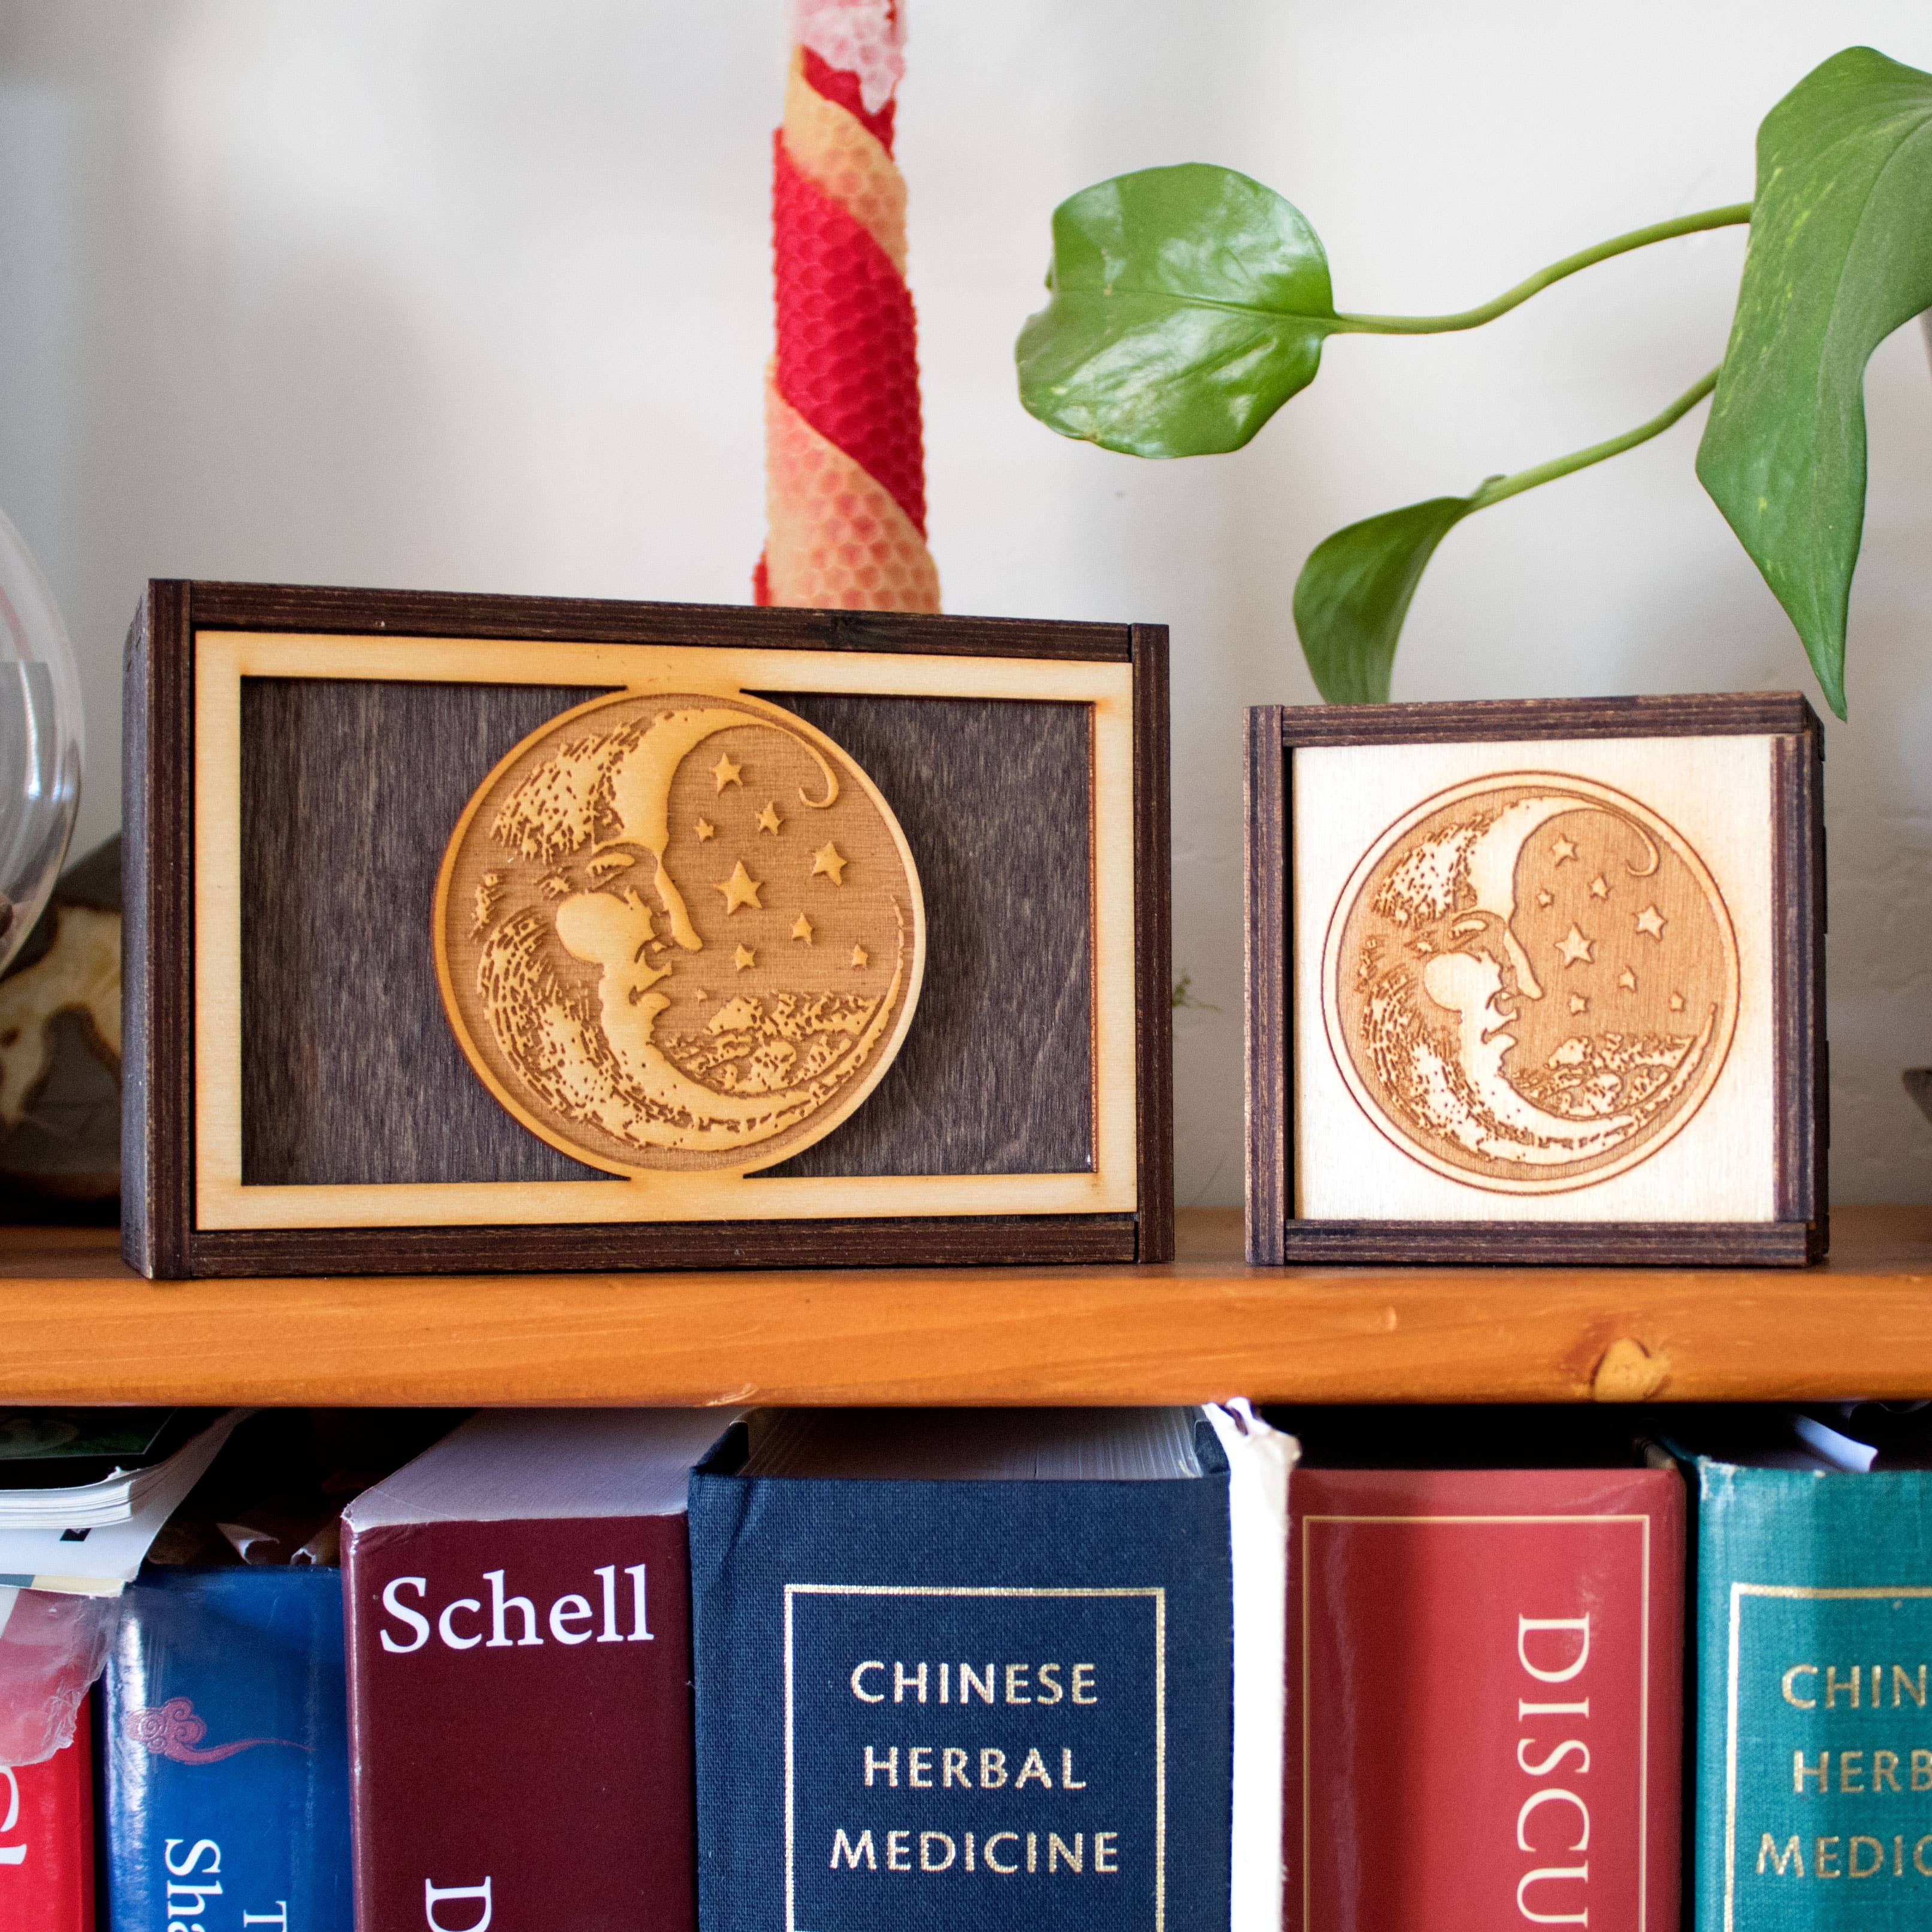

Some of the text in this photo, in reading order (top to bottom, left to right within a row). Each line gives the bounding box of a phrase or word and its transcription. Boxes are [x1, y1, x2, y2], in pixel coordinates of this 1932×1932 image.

[380, 1564, 654, 1653] Schell
[851, 1660, 1097, 1705] CHINESE
[1782, 1664, 1927, 1709] CHIN
[863, 1746, 1087, 1790] HERBAL
[1517, 1611, 1590, 1927] DISCU
[1793, 1749, 1932, 1793] HERB
[830, 1828, 1118, 1874] MEDICINE
